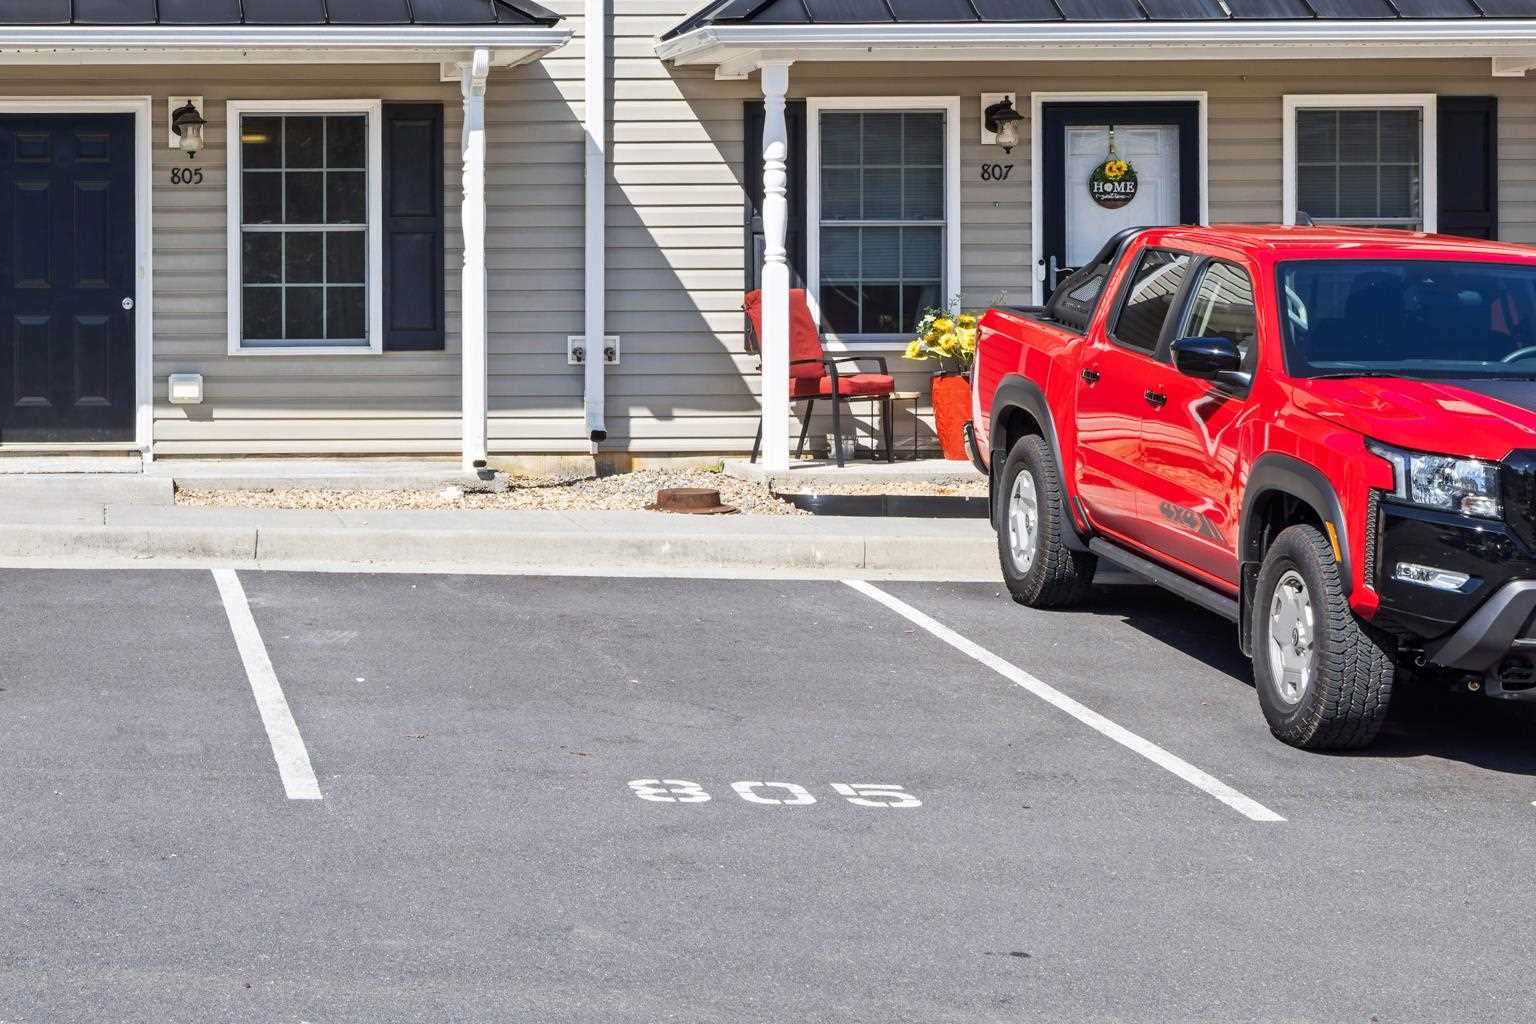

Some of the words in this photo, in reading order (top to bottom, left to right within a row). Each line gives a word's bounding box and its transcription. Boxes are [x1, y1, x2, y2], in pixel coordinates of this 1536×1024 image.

[170, 167, 204, 185] 805
[981, 163, 1014, 181] 807
[1093, 181, 1135, 193] HOME
[627, 778, 923, 807] 805
